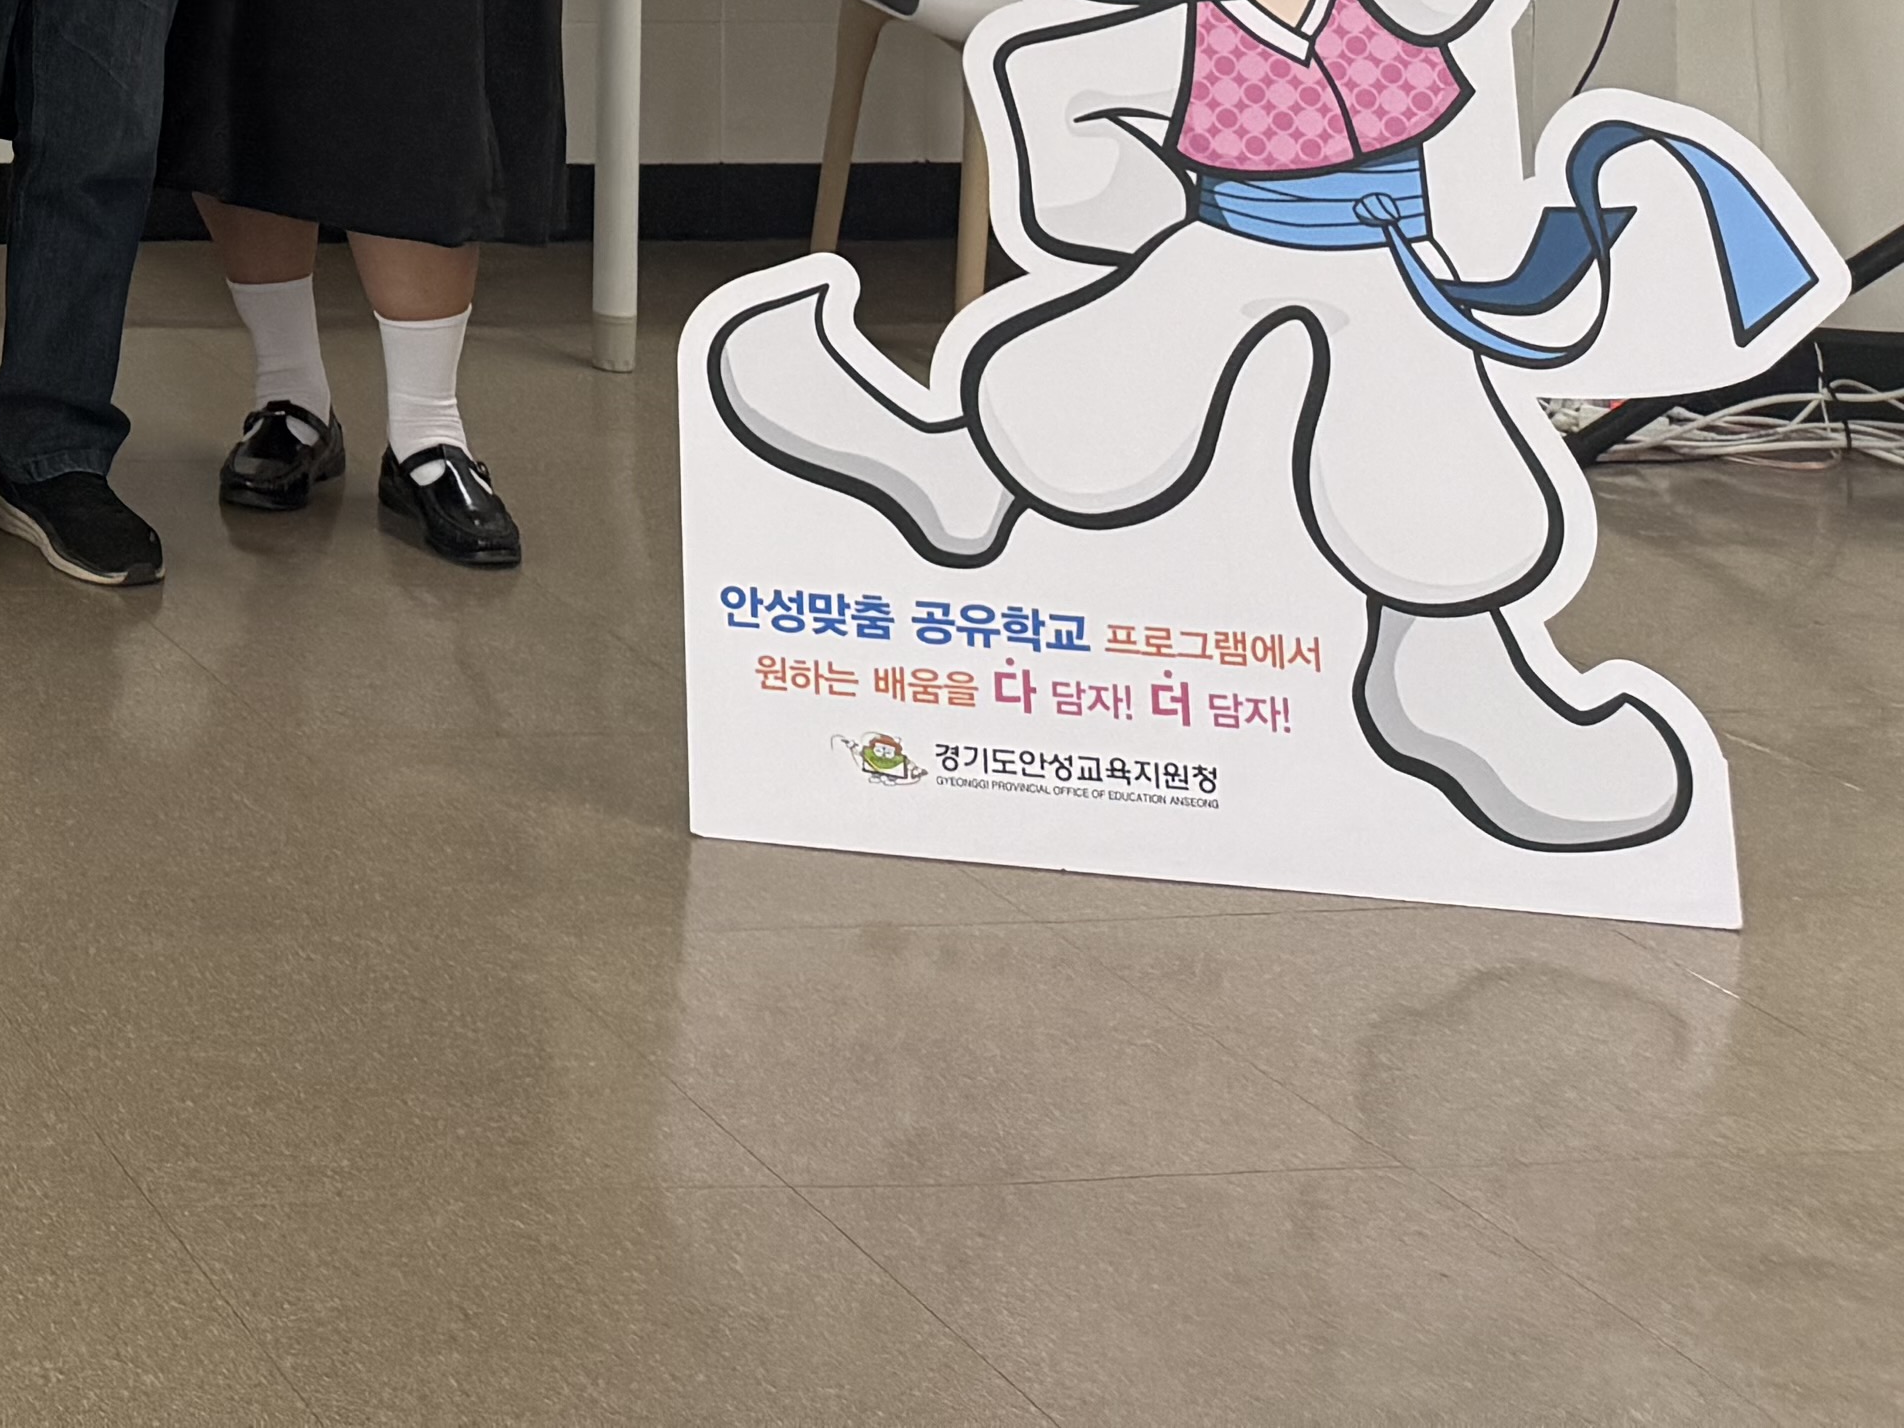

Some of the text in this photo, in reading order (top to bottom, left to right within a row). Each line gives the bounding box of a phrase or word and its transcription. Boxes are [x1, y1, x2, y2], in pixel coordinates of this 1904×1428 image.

[719, 585, 1322, 674] 안성맞춤 공유학교 프로그램에서
[754, 654, 1292, 734] 원하는 배움을 다 담자! 더 담자!
[935, 743, 1218, 794] 경기도안성교육지원청
[991, 780, 1052, 796] PROVINCIAL
[1052, 785, 1090, 799] OFFICE
[1091, 788, 1106, 800] OF
[1108, 790, 1167, 805] EDUCATION
[1169, 795, 1220, 810] ANSEONG
